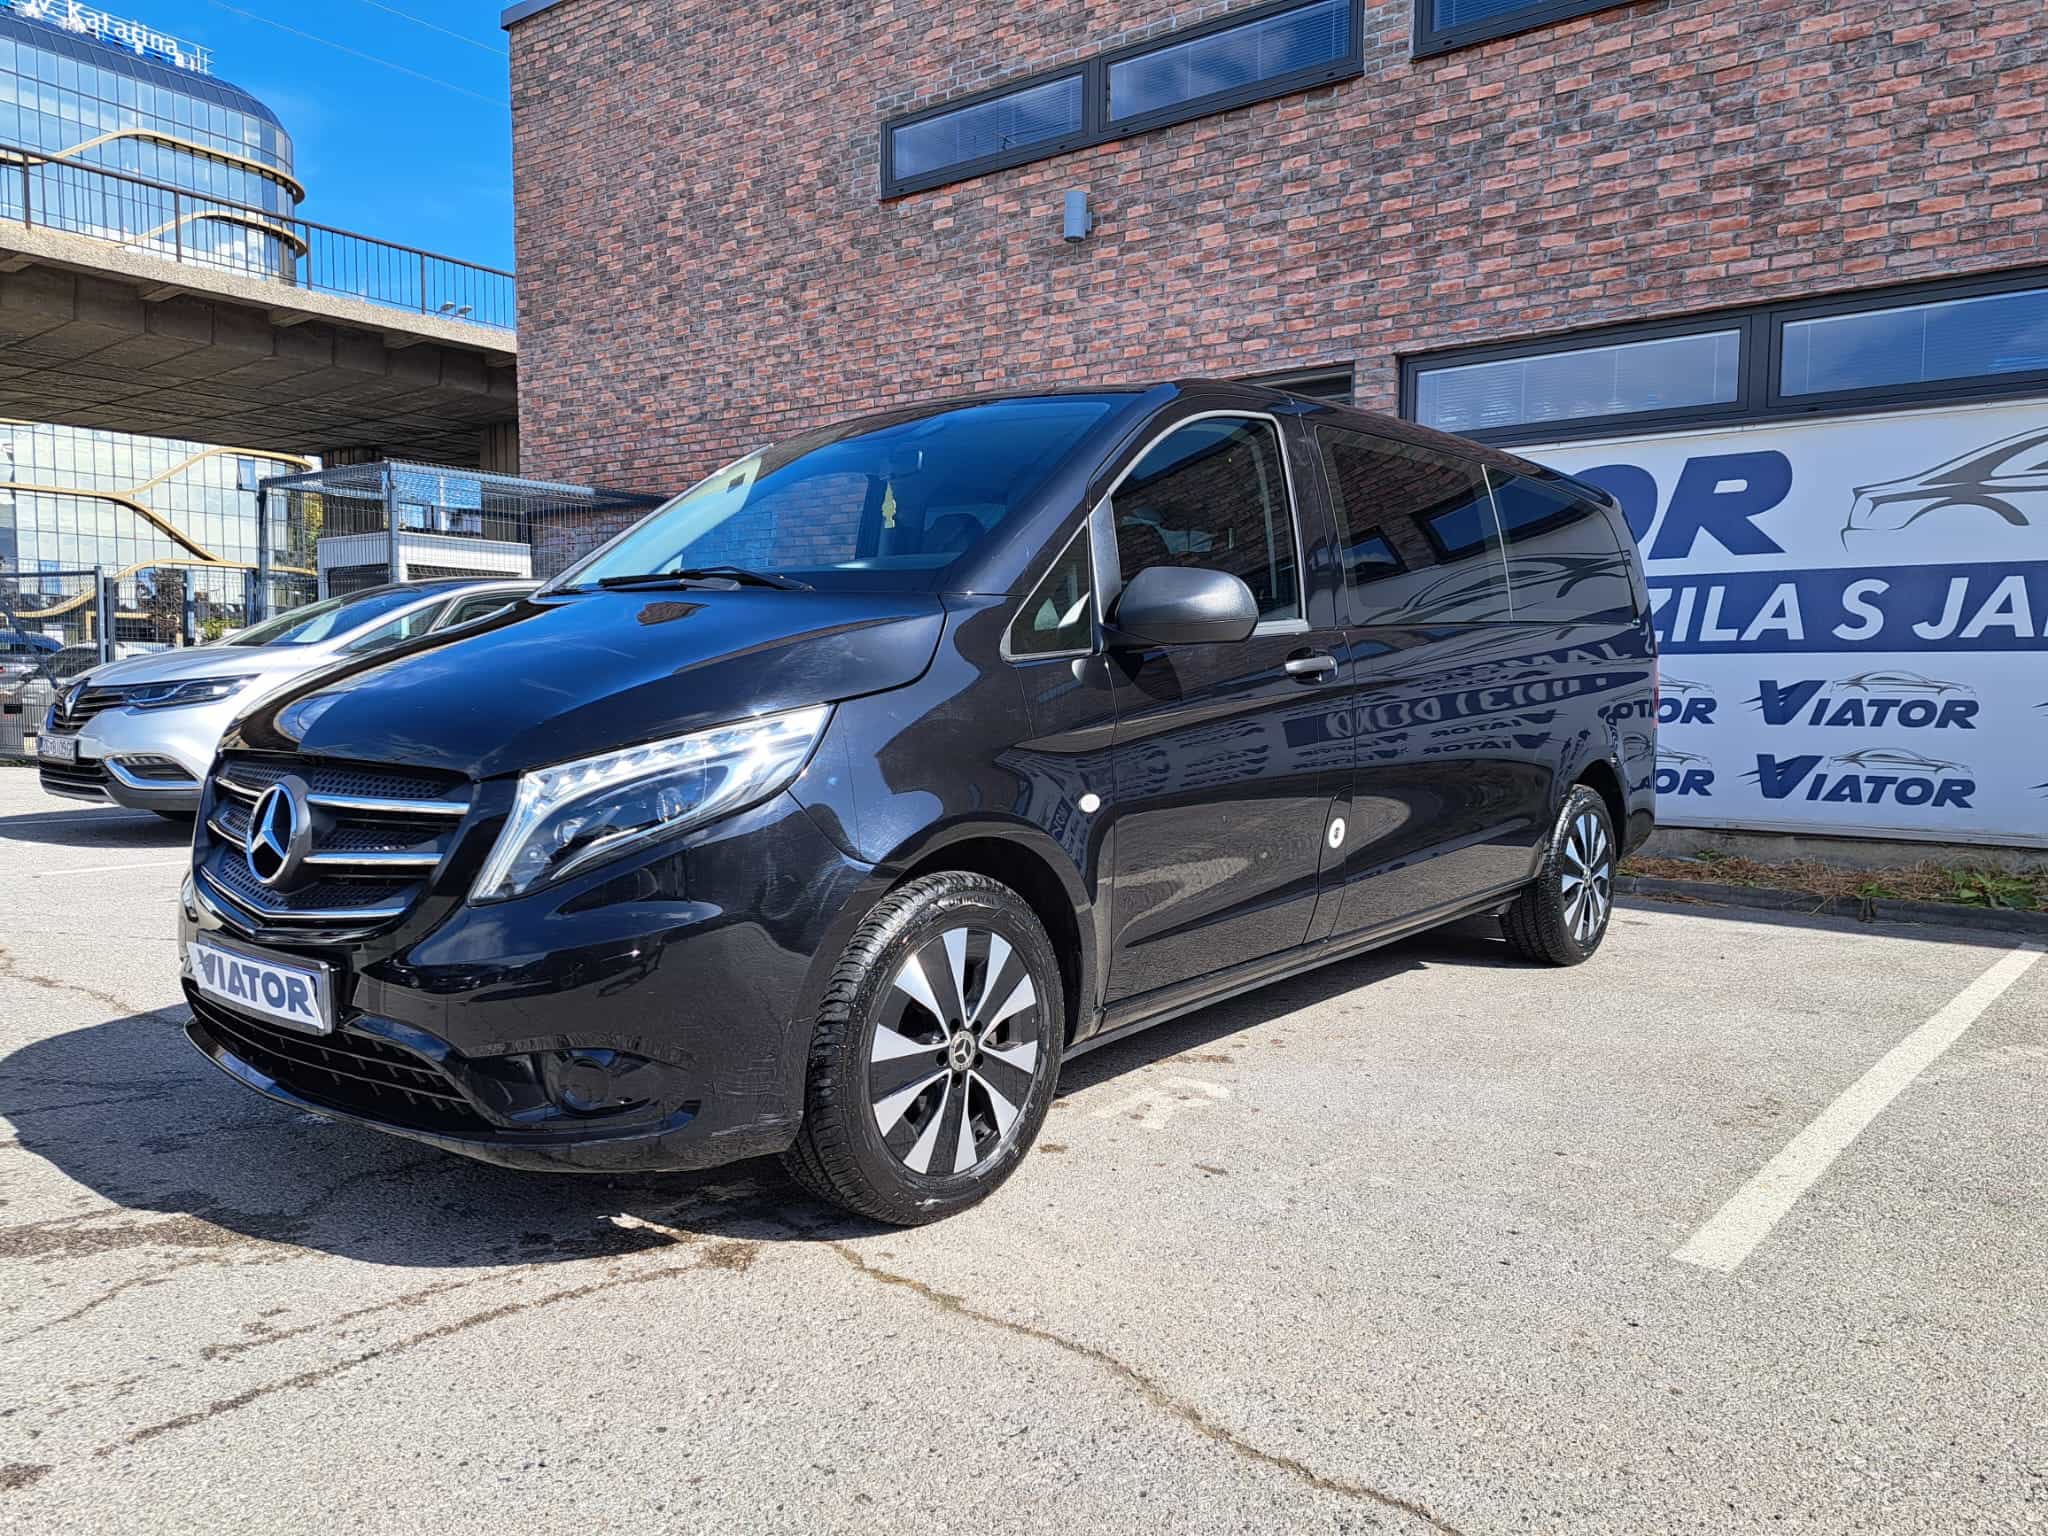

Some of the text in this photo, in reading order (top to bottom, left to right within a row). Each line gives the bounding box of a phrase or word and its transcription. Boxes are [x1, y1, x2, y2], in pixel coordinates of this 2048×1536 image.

[66, 0, 177, 56] Katarina
[1831, 578, 1890, 641] S
[1911, 575, 2048, 640] JA
[1757, 679, 1979, 729] VIATOR
[1756, 753, 1976, 808] VIATOR
[197, 948, 315, 1018] VIATOR
